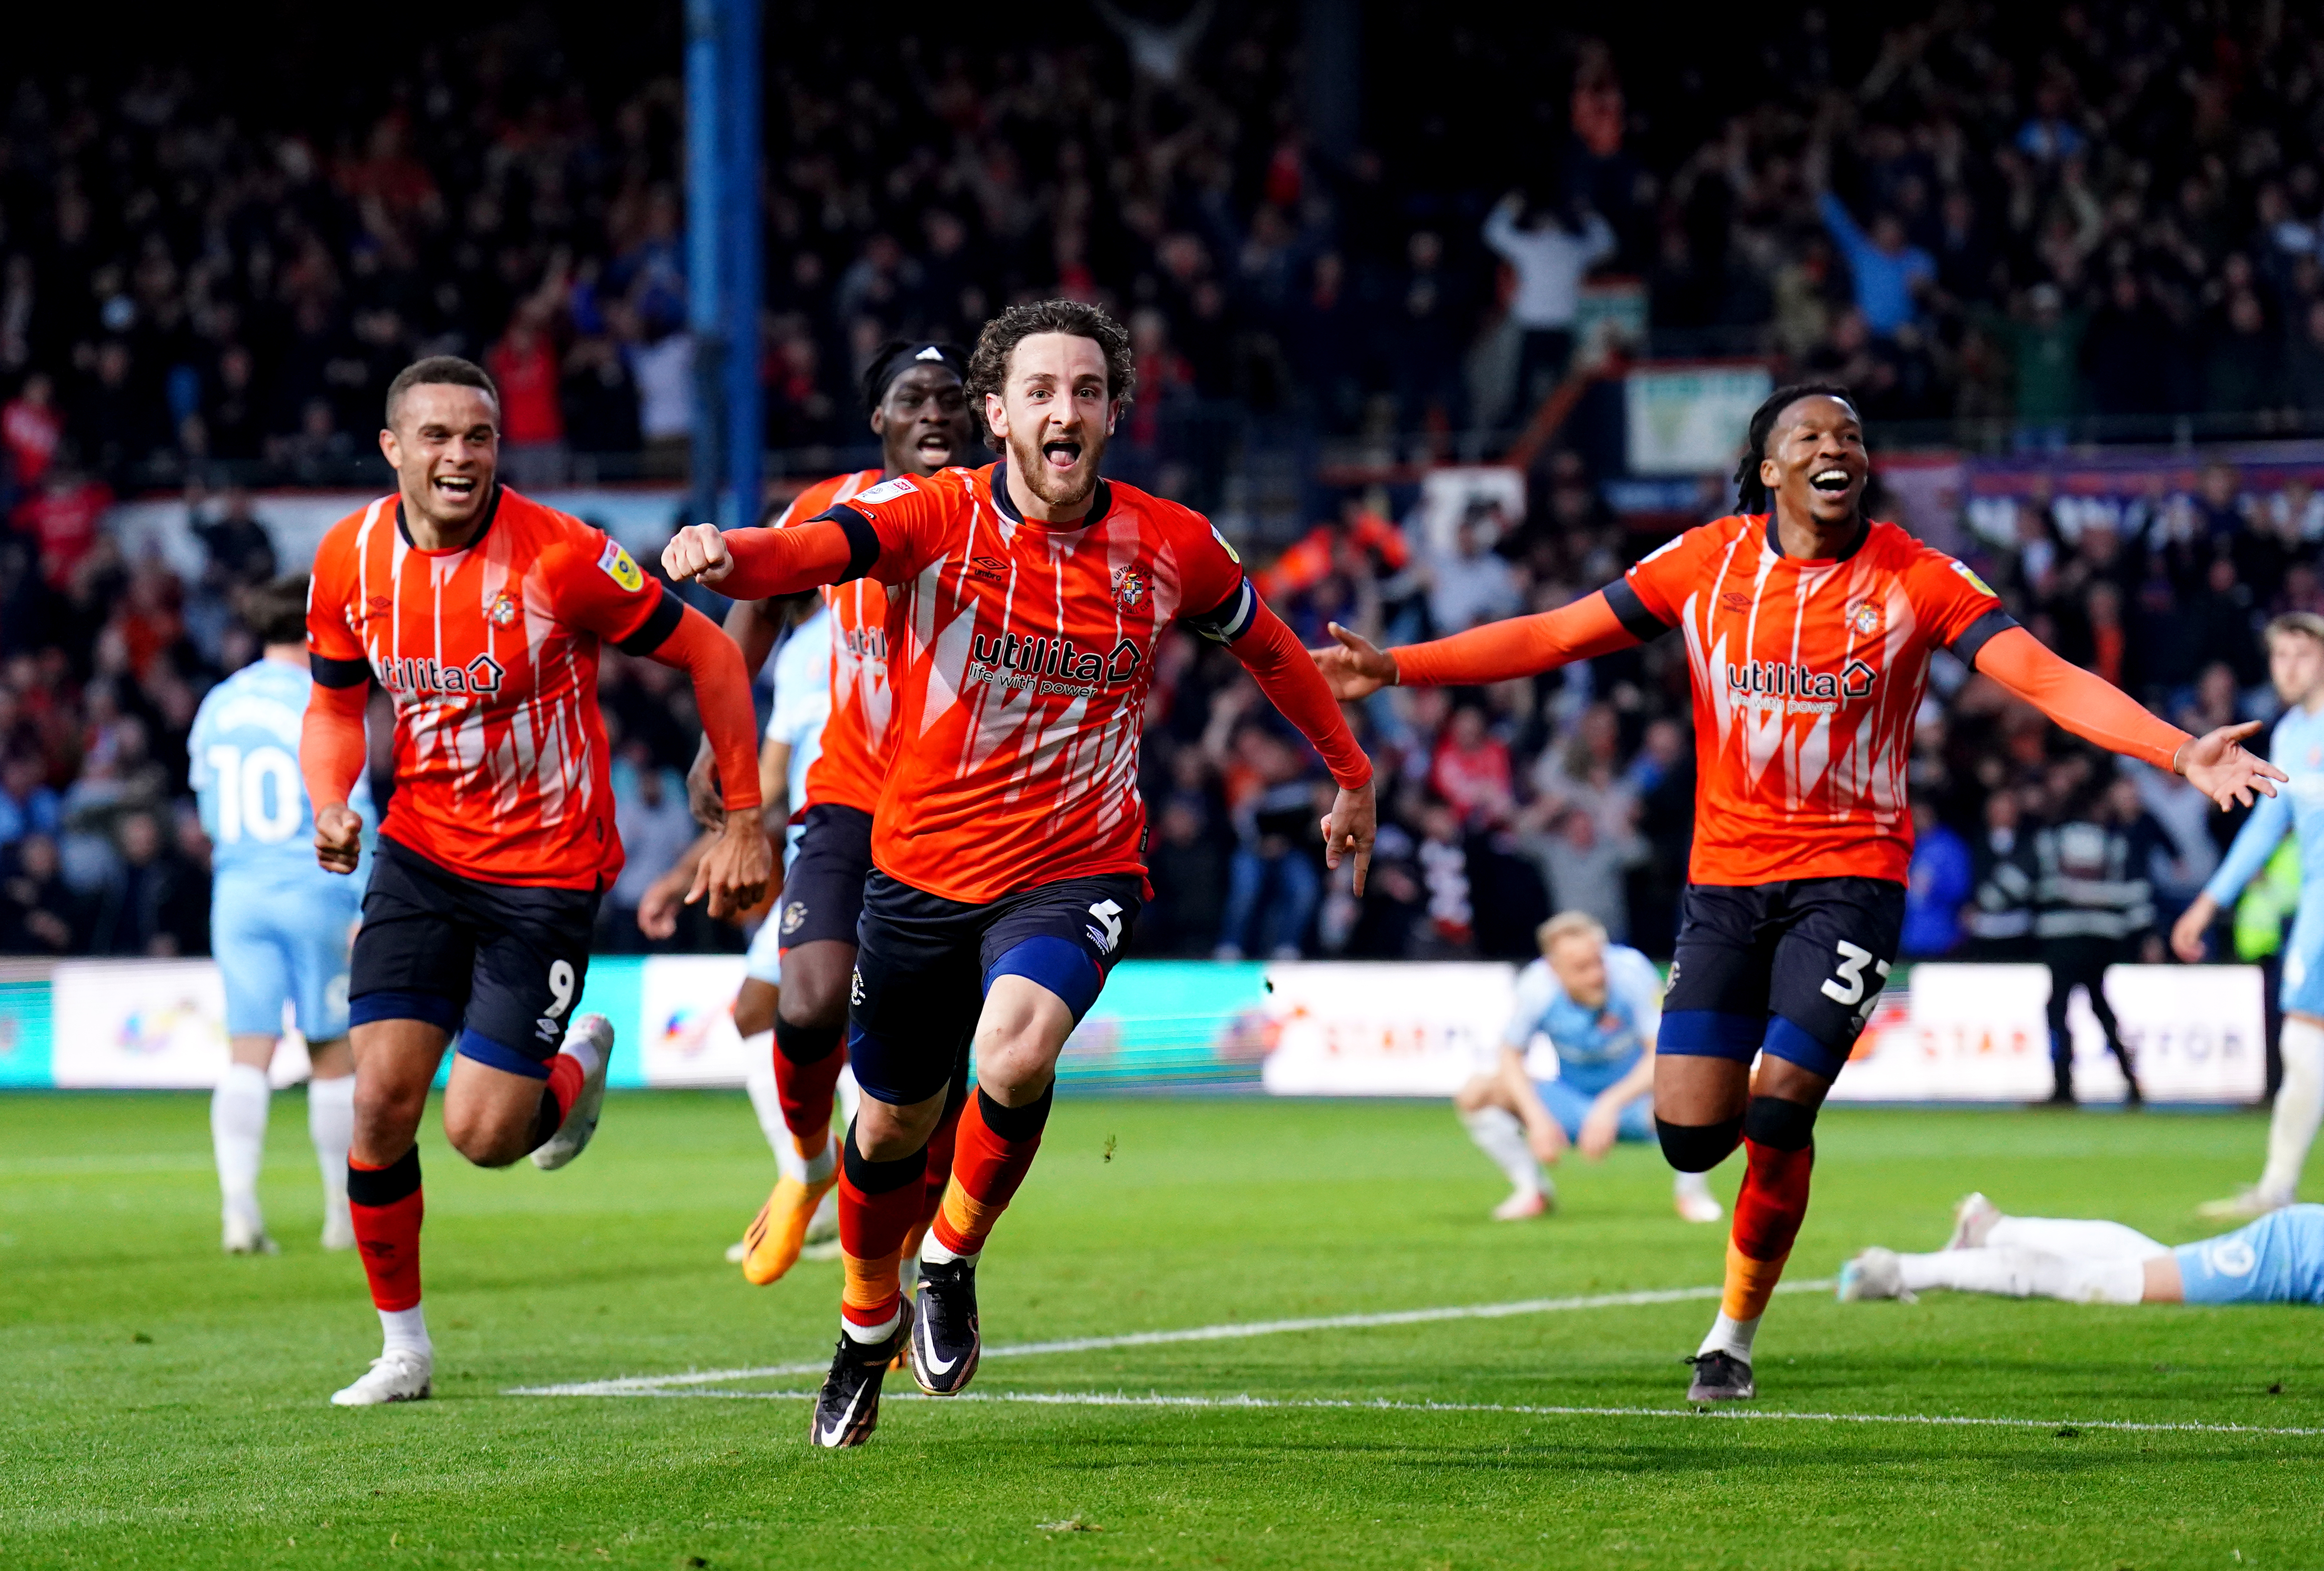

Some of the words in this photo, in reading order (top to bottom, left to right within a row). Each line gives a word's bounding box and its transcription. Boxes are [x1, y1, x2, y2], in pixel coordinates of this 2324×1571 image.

[974, 569, 1001, 581] umbro
[1114, 565, 1132, 580] LUTON
[973, 633, 1103, 681] utilita
[969, 662, 994, 683] life
[999, 673, 1036, 691] with
[1039, 681, 1098, 698] power
[1727, 659, 1838, 698] utilita
[1787, 700, 1838, 715] power
[206, 744, 302, 844] 10
[1086, 932, 1105, 956] umbro
[543, 959, 575, 1019] 9
